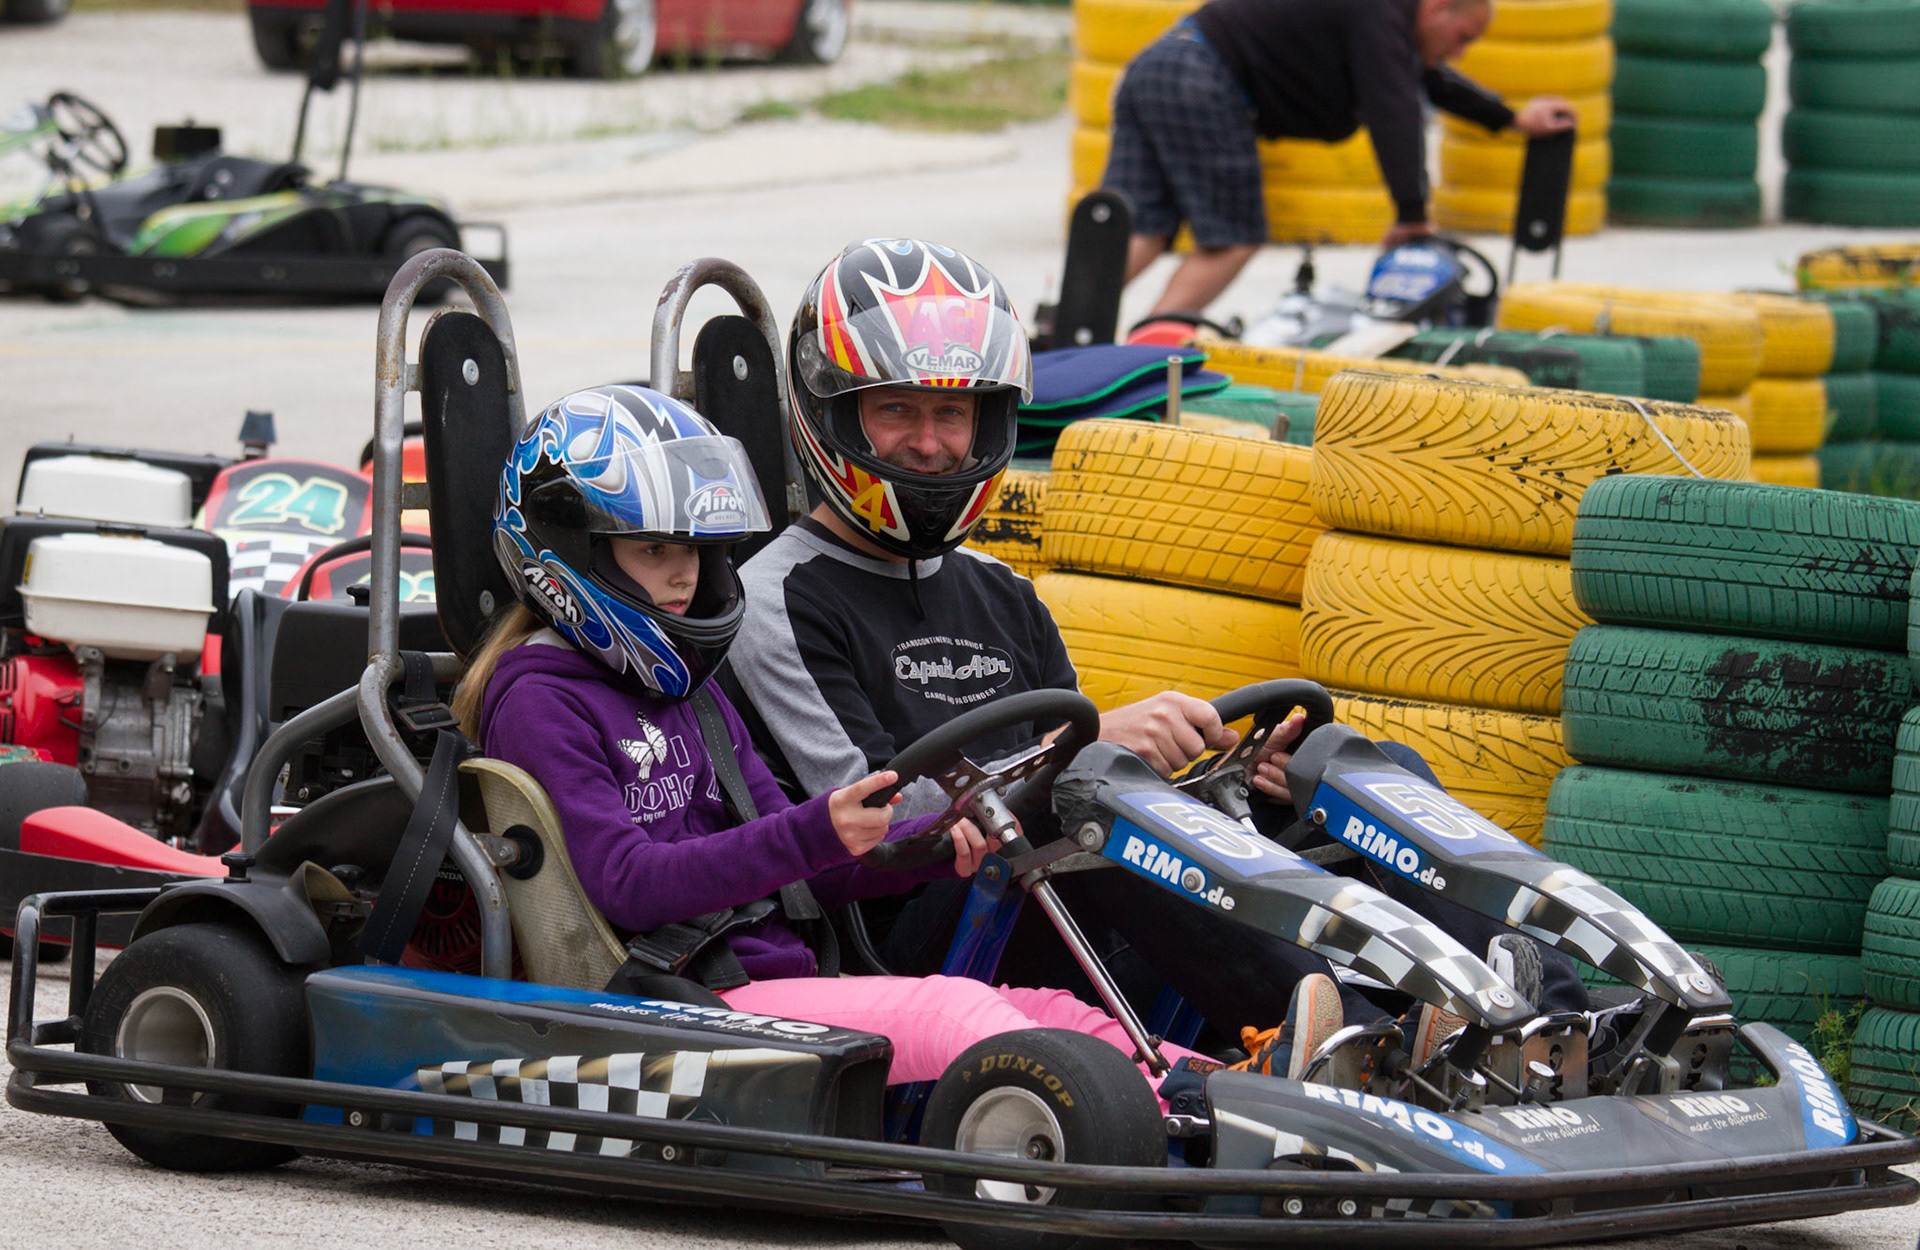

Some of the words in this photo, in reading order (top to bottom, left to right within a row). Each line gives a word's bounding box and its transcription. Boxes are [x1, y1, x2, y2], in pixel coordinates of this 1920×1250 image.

[913, 353, 976, 370] VEMAR
[228, 473, 348, 534] 24
[851, 482, 888, 533] 4
[523, 567, 577, 623] Airoh
[955, 655, 1011, 680] Air
[436, 870, 465, 882] ONDA
[1342, 815, 1448, 891] RiMO.de
[980, 1053, 1076, 1108] DUNLOP
